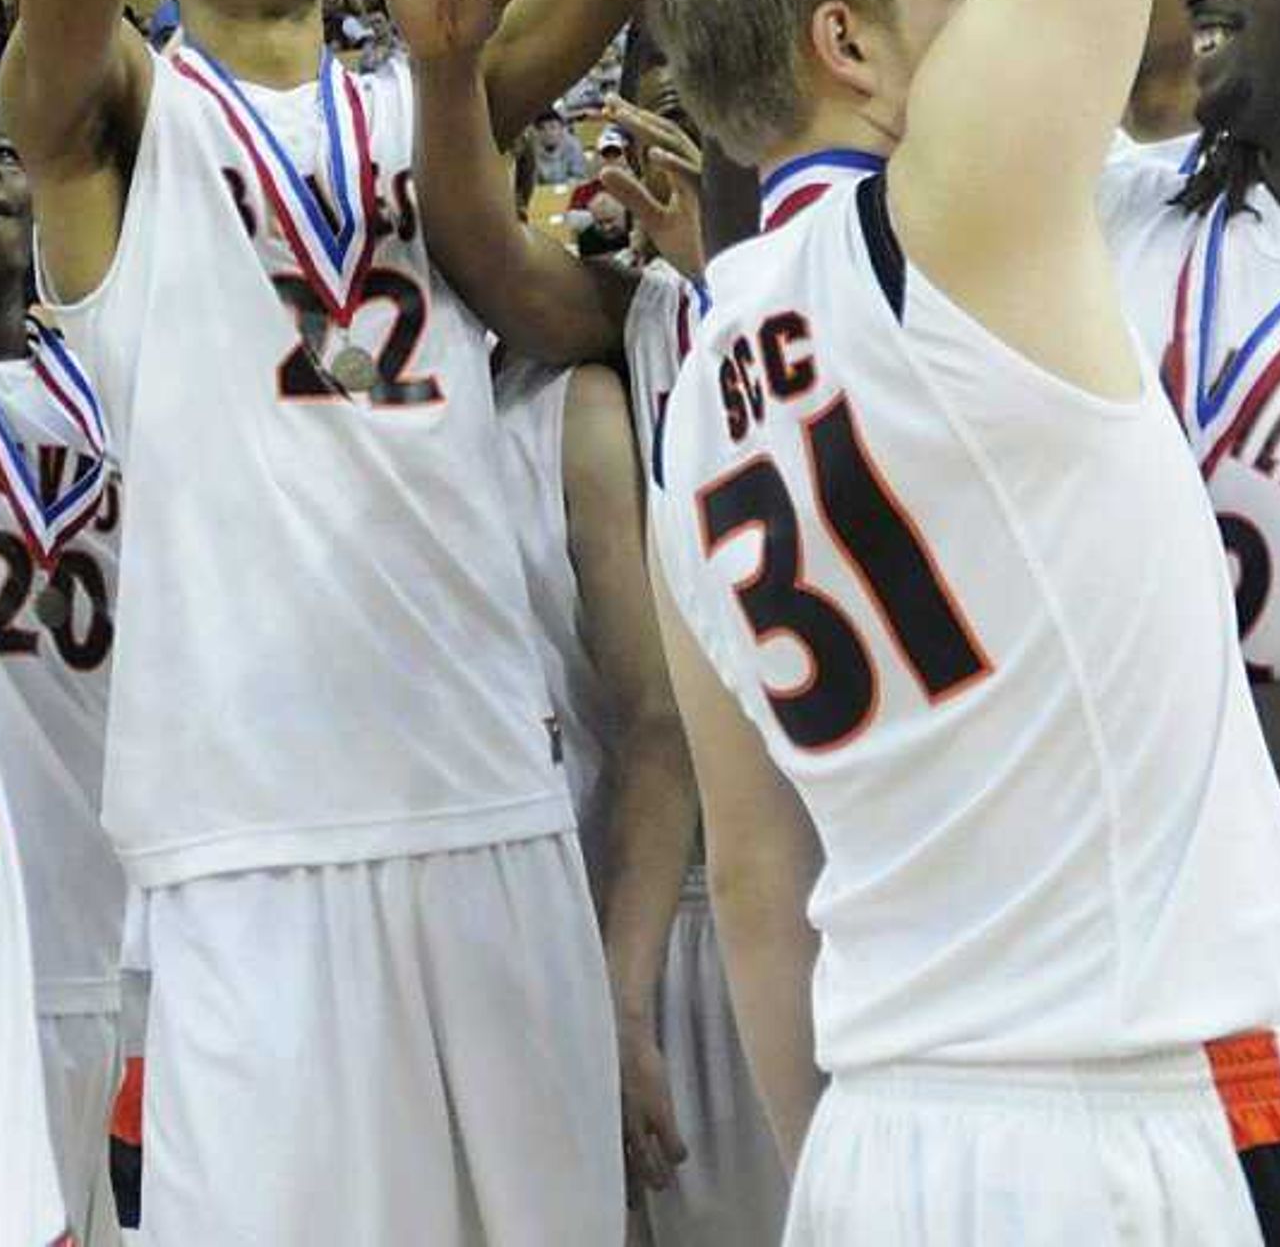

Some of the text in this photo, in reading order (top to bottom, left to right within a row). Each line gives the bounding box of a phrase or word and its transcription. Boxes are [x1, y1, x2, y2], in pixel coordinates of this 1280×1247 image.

[270, 267, 447, 411] 22
[720, 310, 818, 444] SCC
[694, 390, 997, 755] 31
